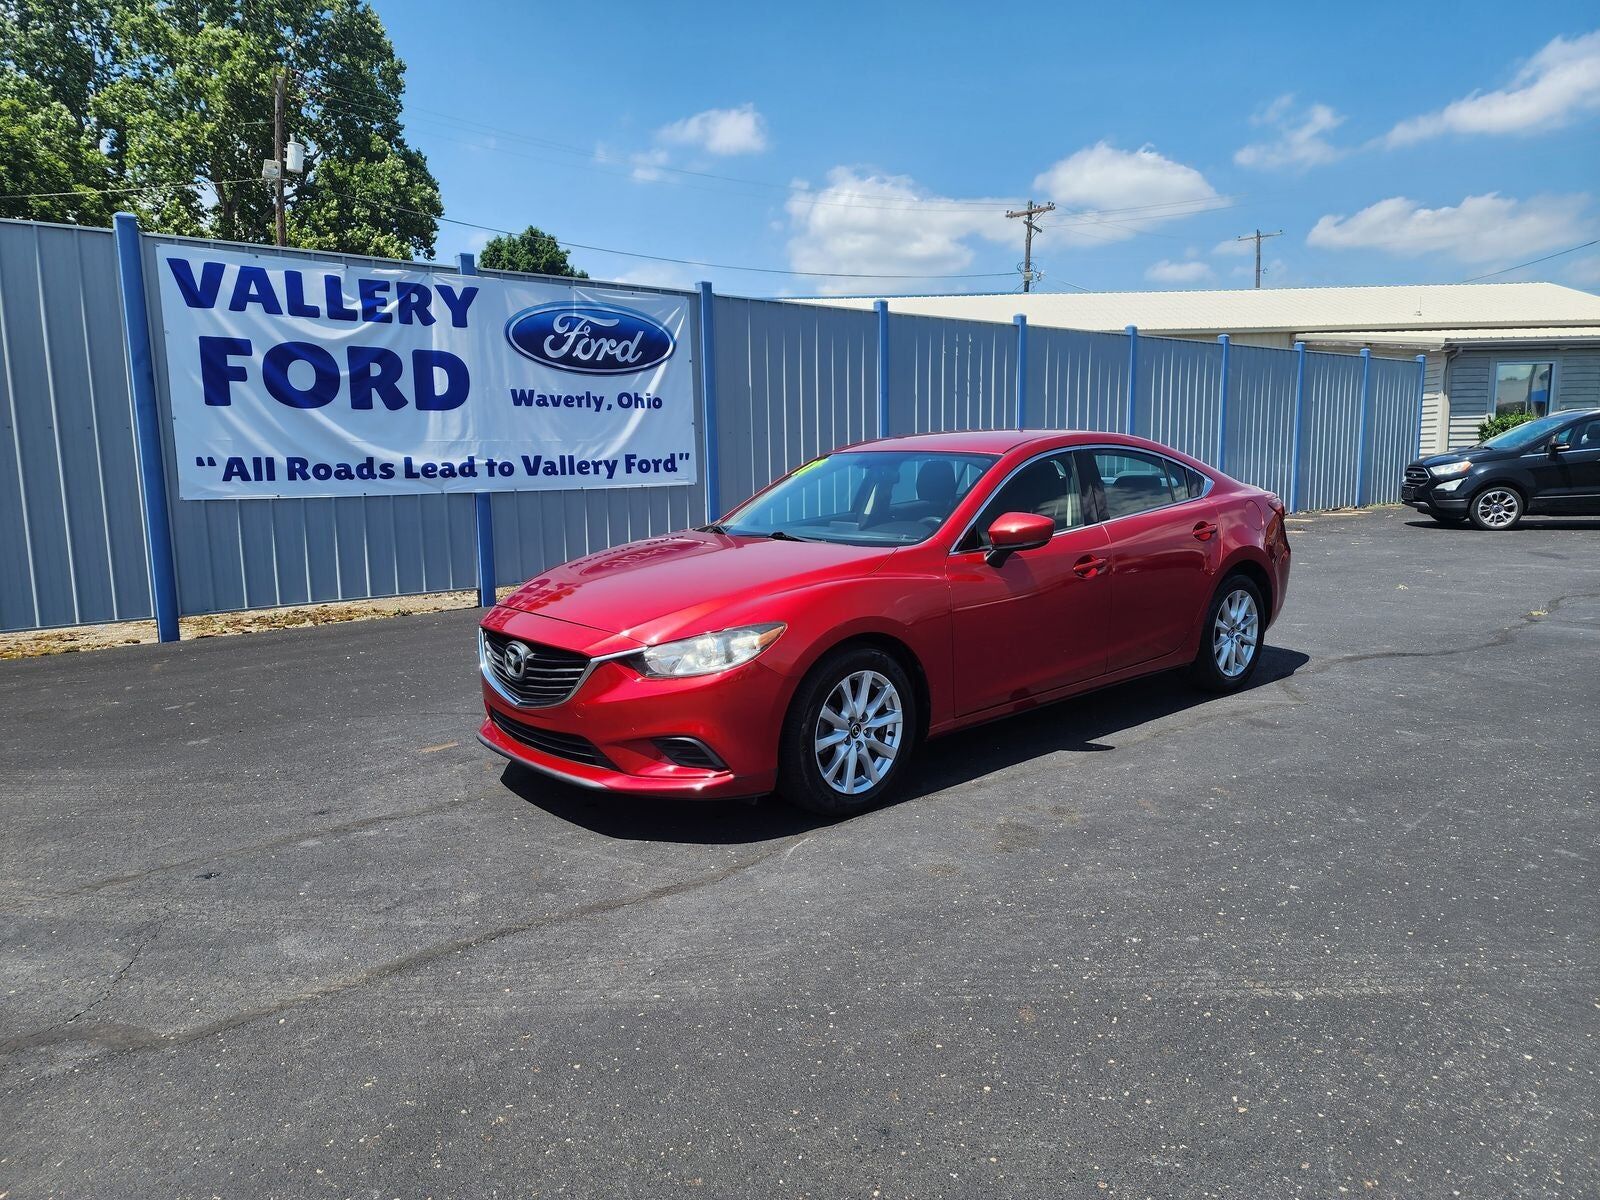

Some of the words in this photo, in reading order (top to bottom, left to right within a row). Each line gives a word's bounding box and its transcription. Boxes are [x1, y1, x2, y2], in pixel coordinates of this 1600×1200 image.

[166, 257, 480, 328] VALLERY
[543, 312, 645, 364] Ford
[198, 335, 470, 411] FORD
[510, 388, 613, 412] Waverly,
[616, 391, 663, 410] Ohio
[286, 456, 396, 481] Roads
[403, 456, 478, 479] Lead
[485, 457, 515, 477] to
[520, 454, 619, 480] Vallery
